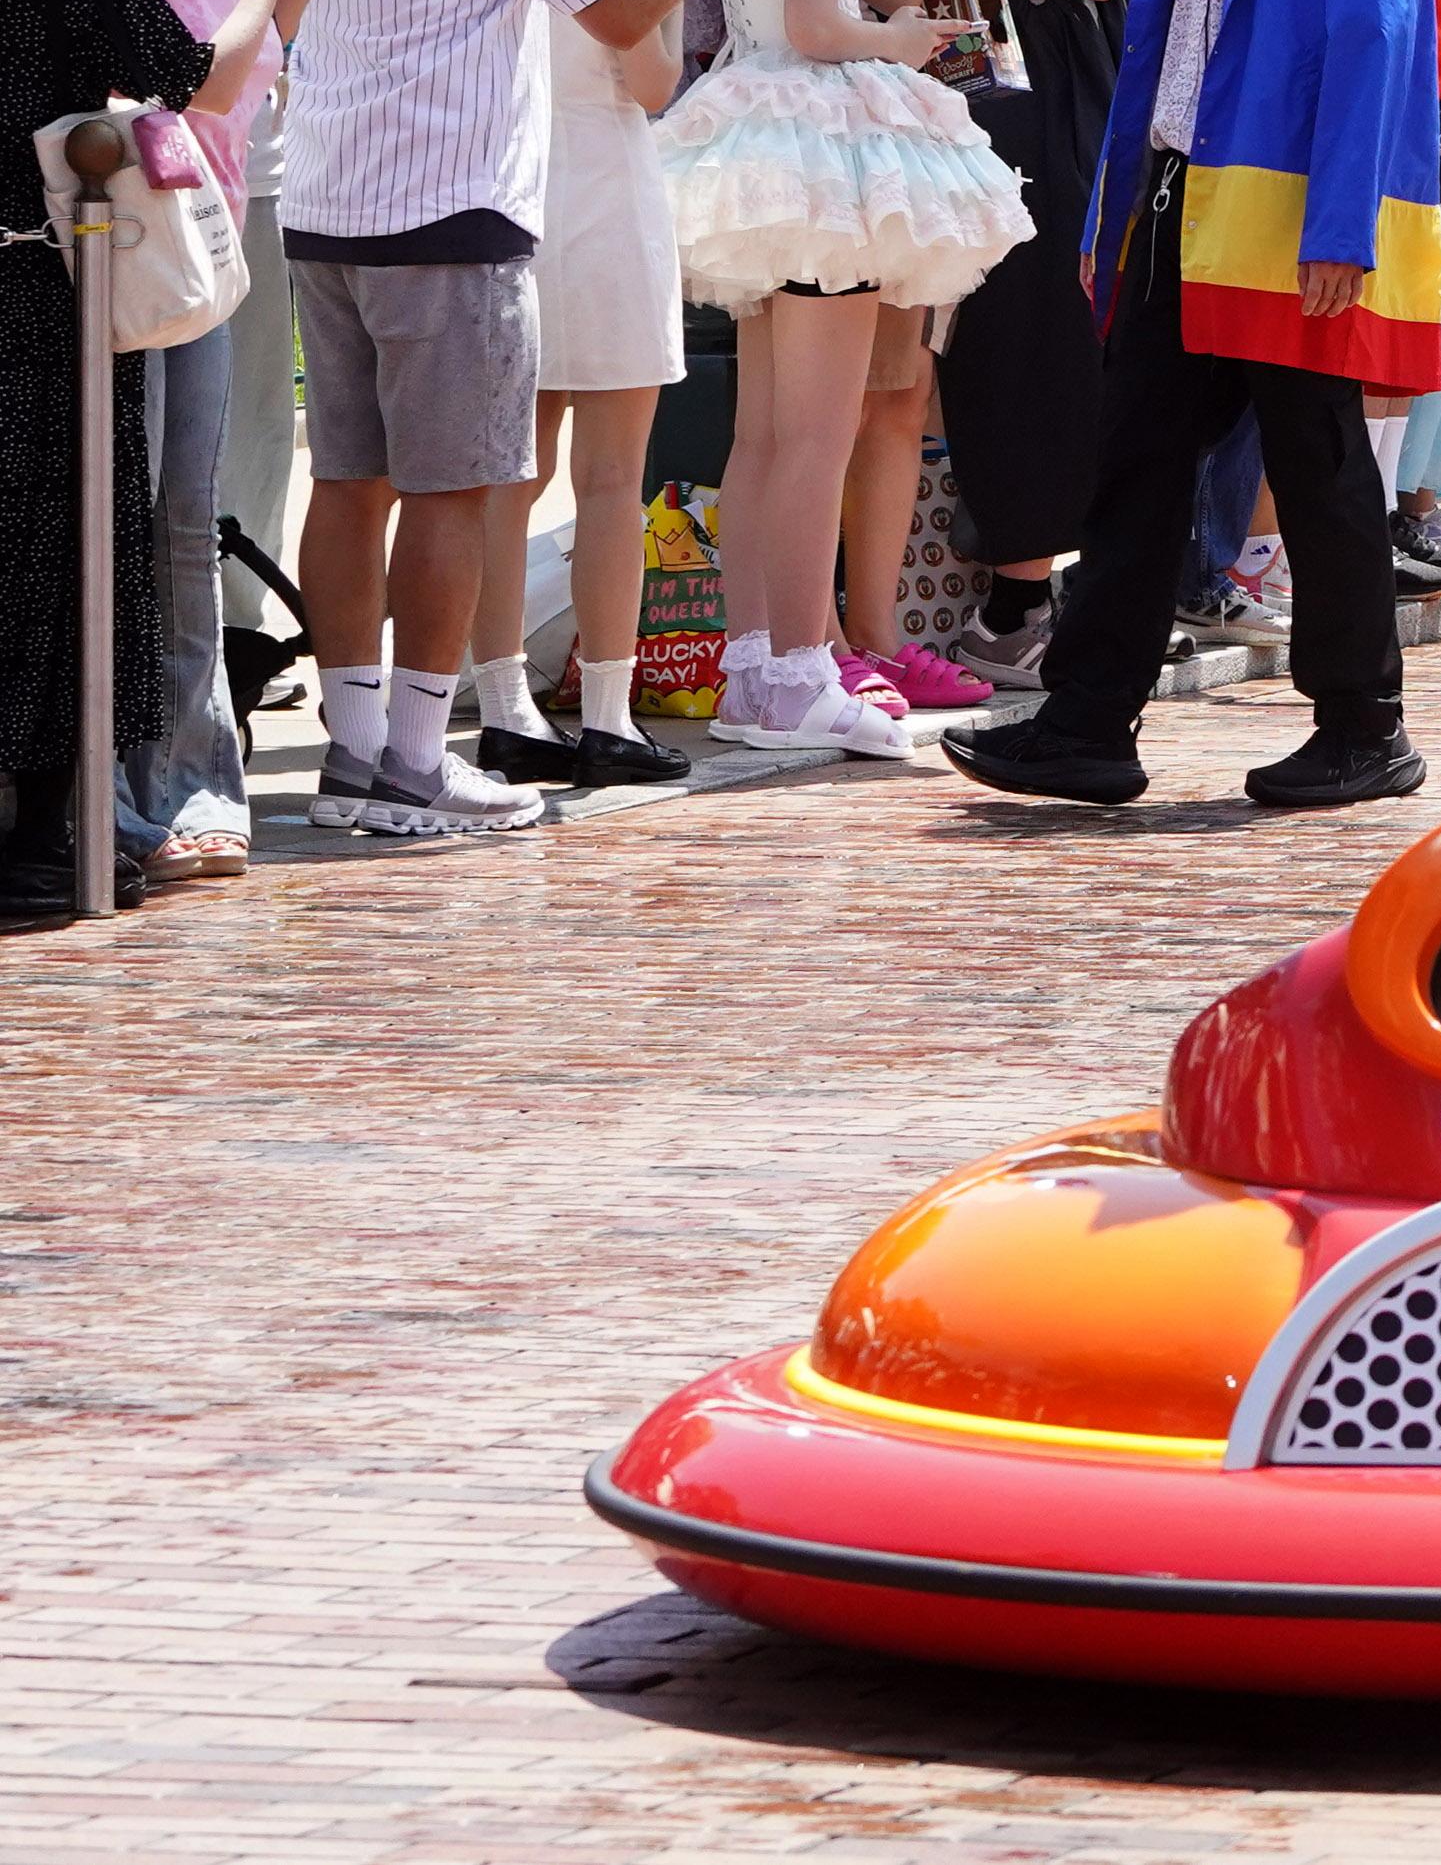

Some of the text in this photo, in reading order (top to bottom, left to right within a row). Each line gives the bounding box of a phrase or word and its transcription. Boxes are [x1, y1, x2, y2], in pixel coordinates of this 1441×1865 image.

[647, 579, 677, 600] I'M
[648, 599, 718, 624] QUEEN
[640, 639, 721, 663] LUCKY
[642, 662, 697, 685] DAY!
